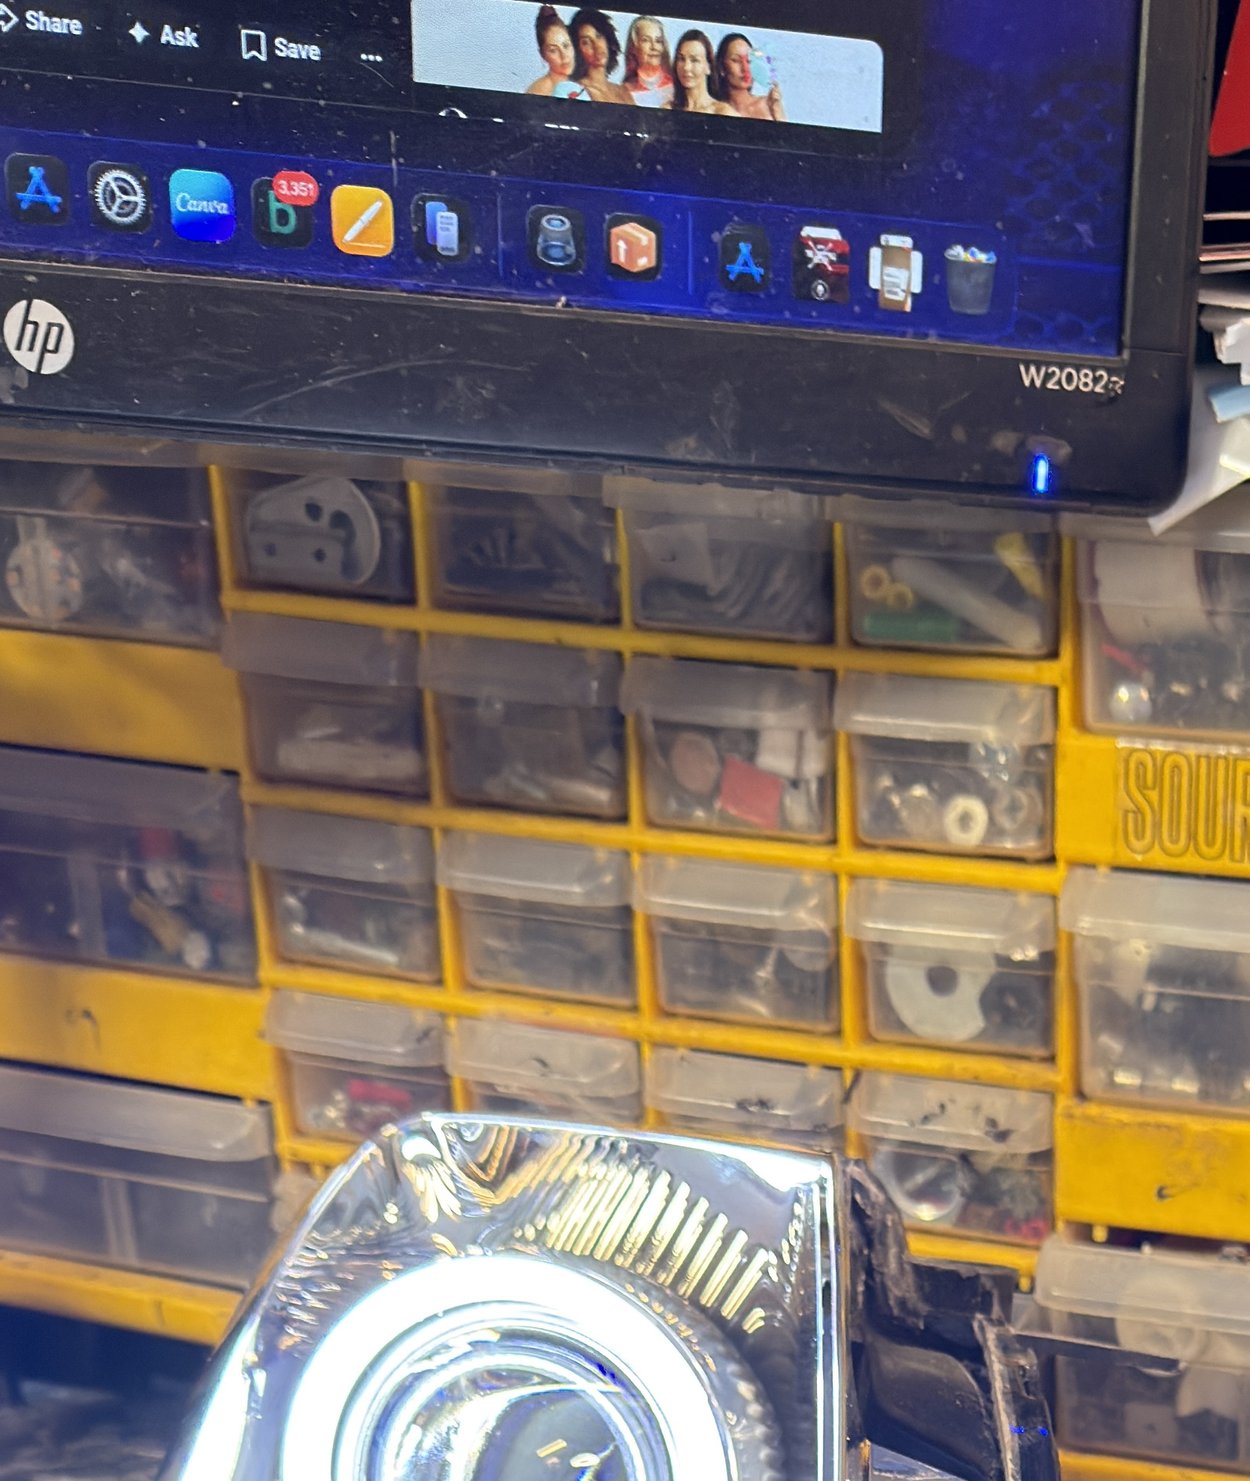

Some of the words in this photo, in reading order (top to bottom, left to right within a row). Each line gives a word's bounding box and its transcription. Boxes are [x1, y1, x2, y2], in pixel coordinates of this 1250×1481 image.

[26, 10, 83, 37] Share
[160, 24, 199, 48] Ask
[274, 38, 321, 61] Save
[175, 192, 230, 215] Canva
[14, 300, 65, 374] hp
